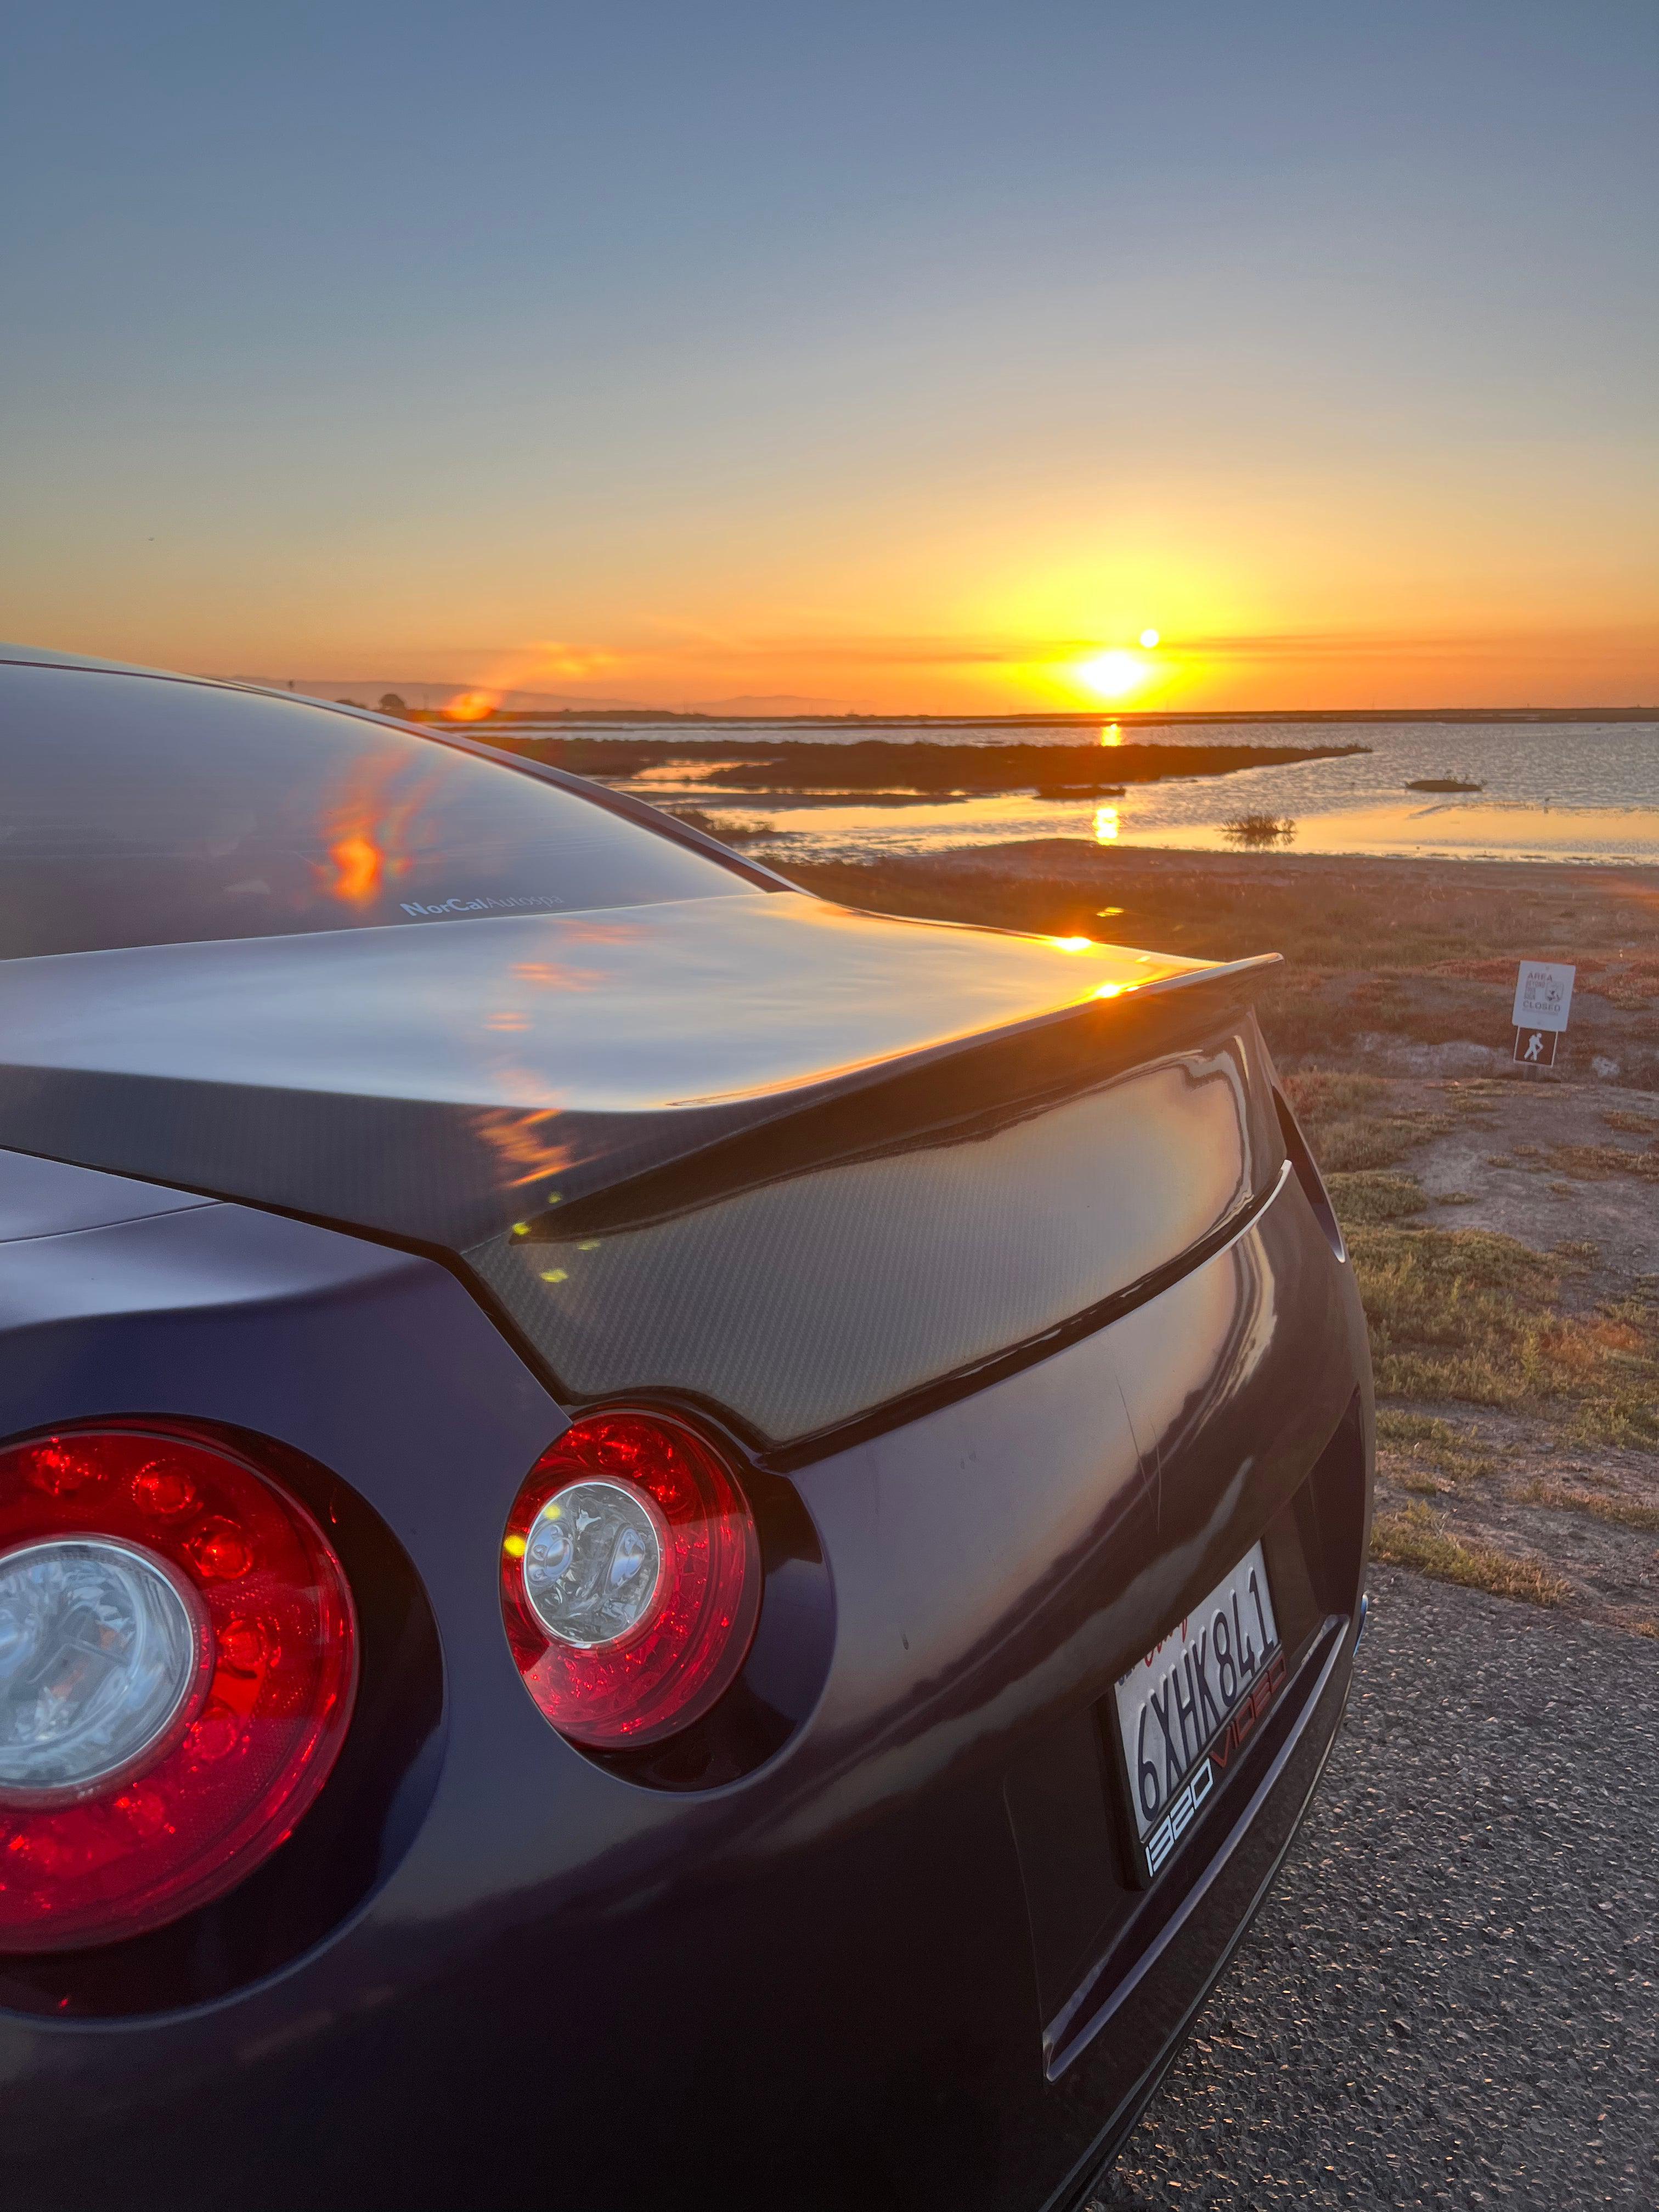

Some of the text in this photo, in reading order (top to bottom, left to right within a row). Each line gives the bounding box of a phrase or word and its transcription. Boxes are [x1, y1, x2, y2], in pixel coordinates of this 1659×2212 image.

[1527, 972, 1553, 981] AREA
[1522, 1000, 1561, 1012] CLOSED
[1137, 1566, 1276, 1822] 6XHK841
